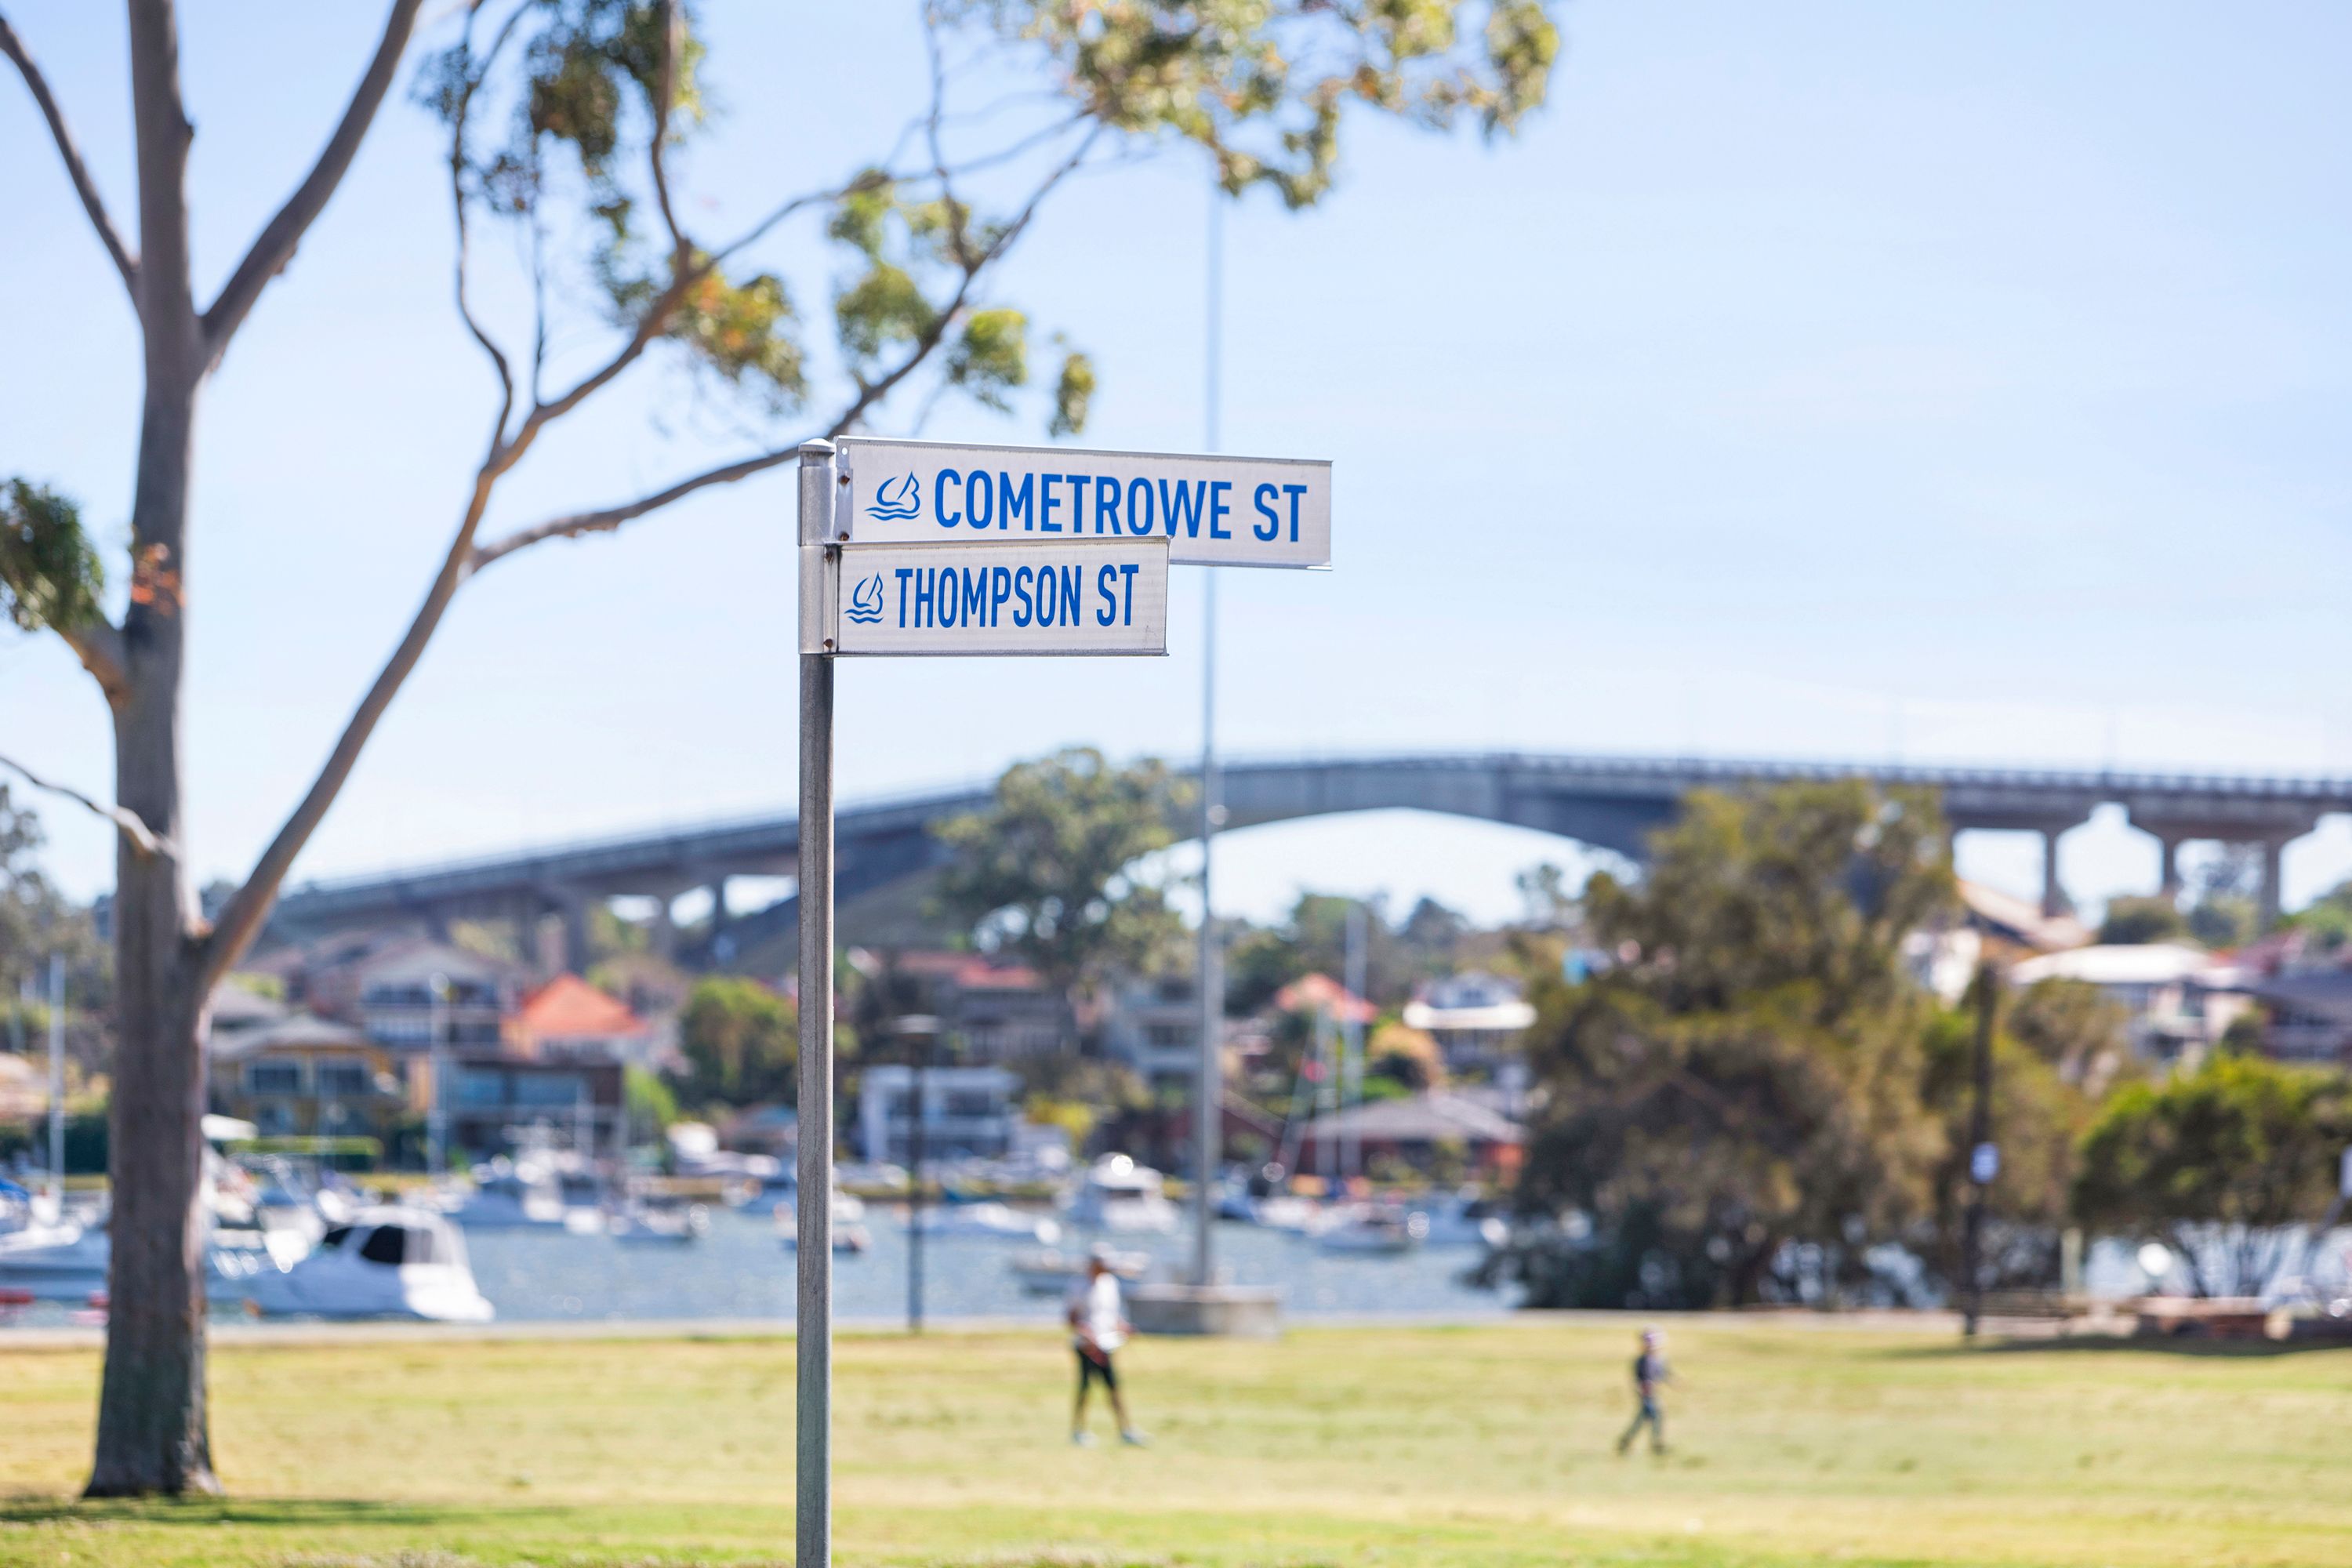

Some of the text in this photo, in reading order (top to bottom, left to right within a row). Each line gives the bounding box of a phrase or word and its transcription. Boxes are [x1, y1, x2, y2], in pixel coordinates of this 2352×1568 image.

[935, 468, 1308, 543] COMETROWE ST
[895, 564, 1139, 629] THOMPSON ST
